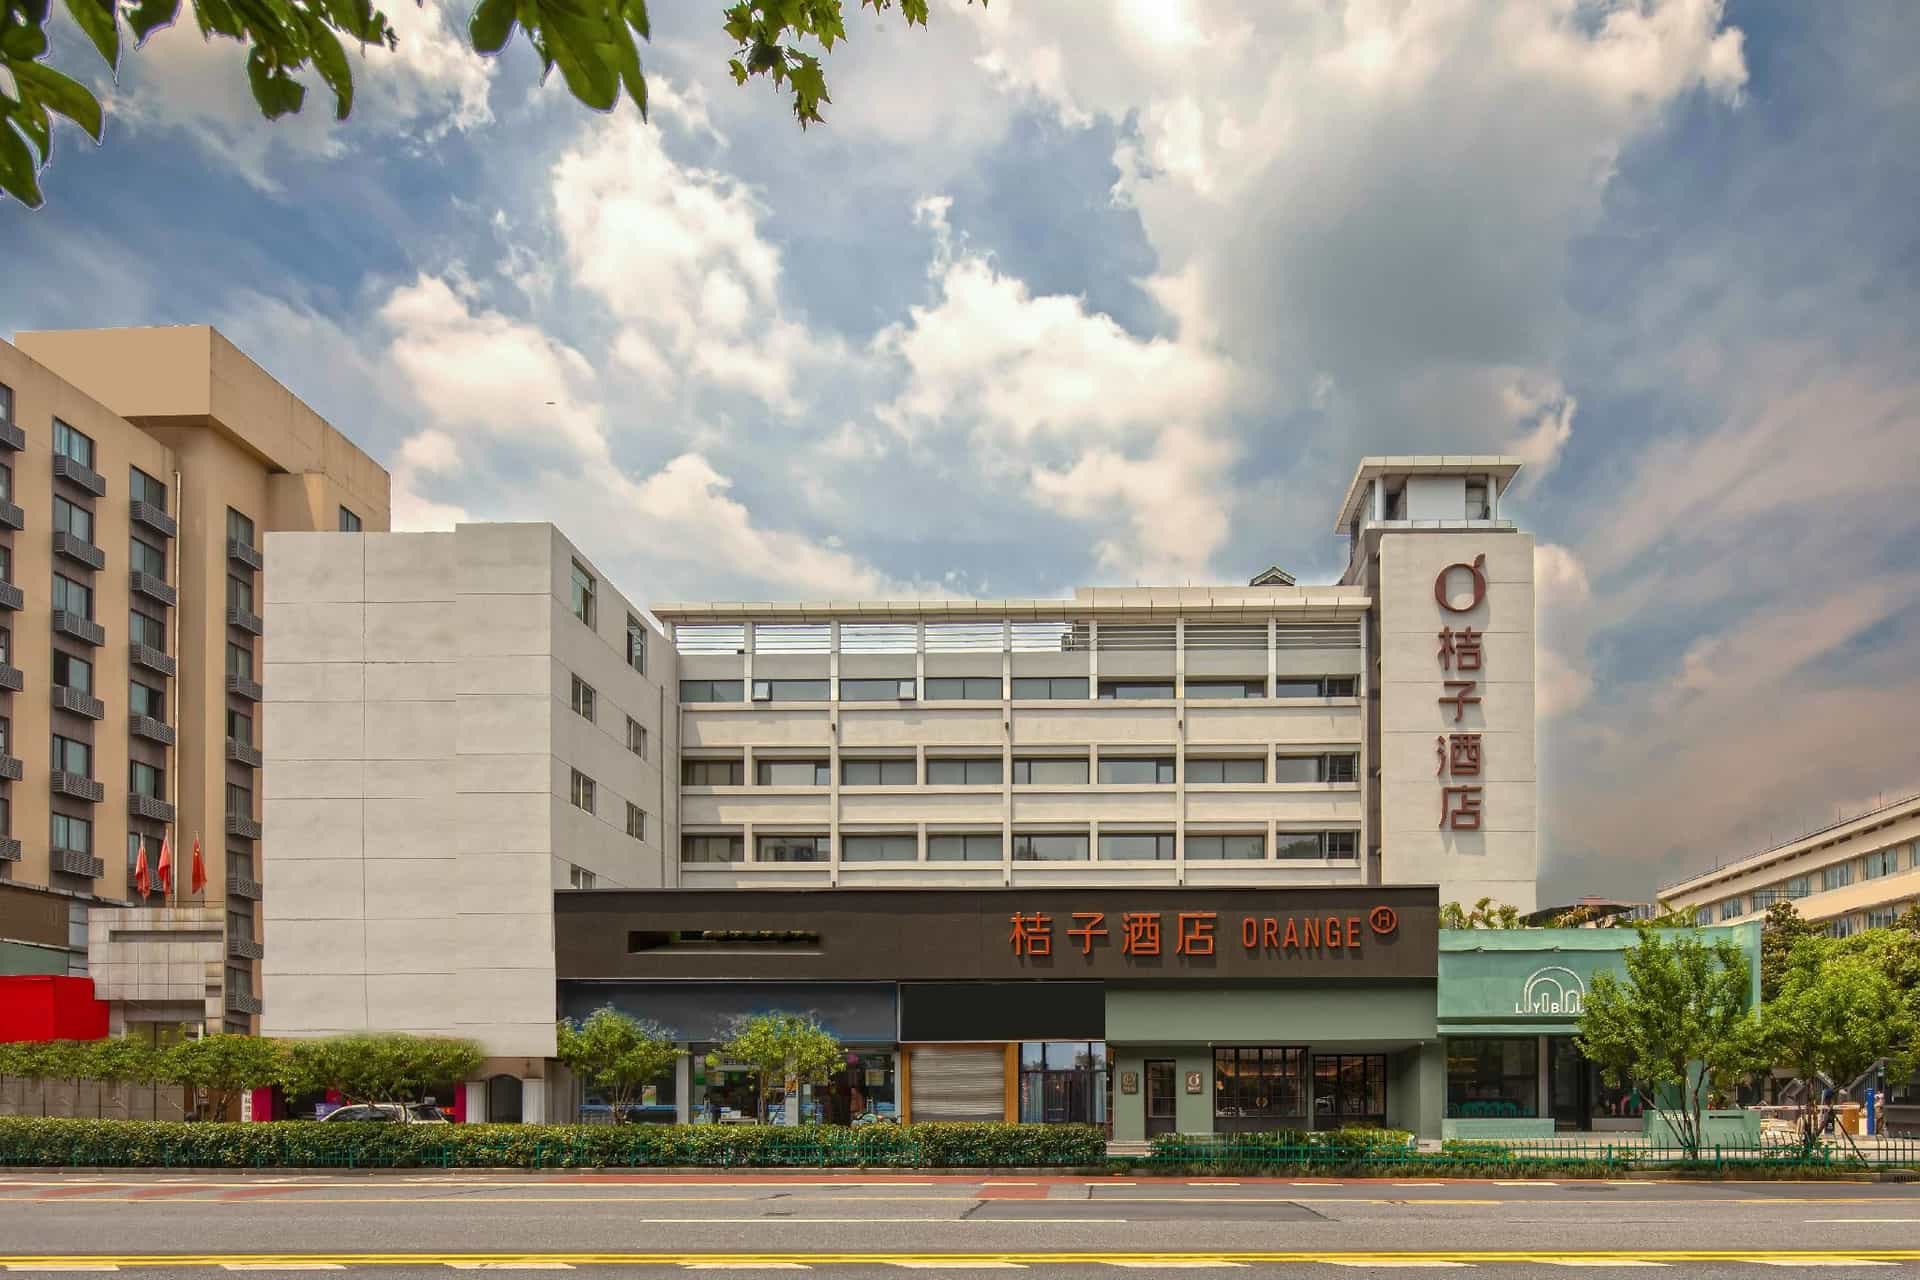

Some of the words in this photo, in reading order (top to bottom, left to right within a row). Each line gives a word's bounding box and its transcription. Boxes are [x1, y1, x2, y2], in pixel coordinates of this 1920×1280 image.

[1437, 626, 1482, 830] 桔子酒店
[1008, 911, 1217, 956] 桔子酒店
[1242, 917, 1361, 948] ORANGE
